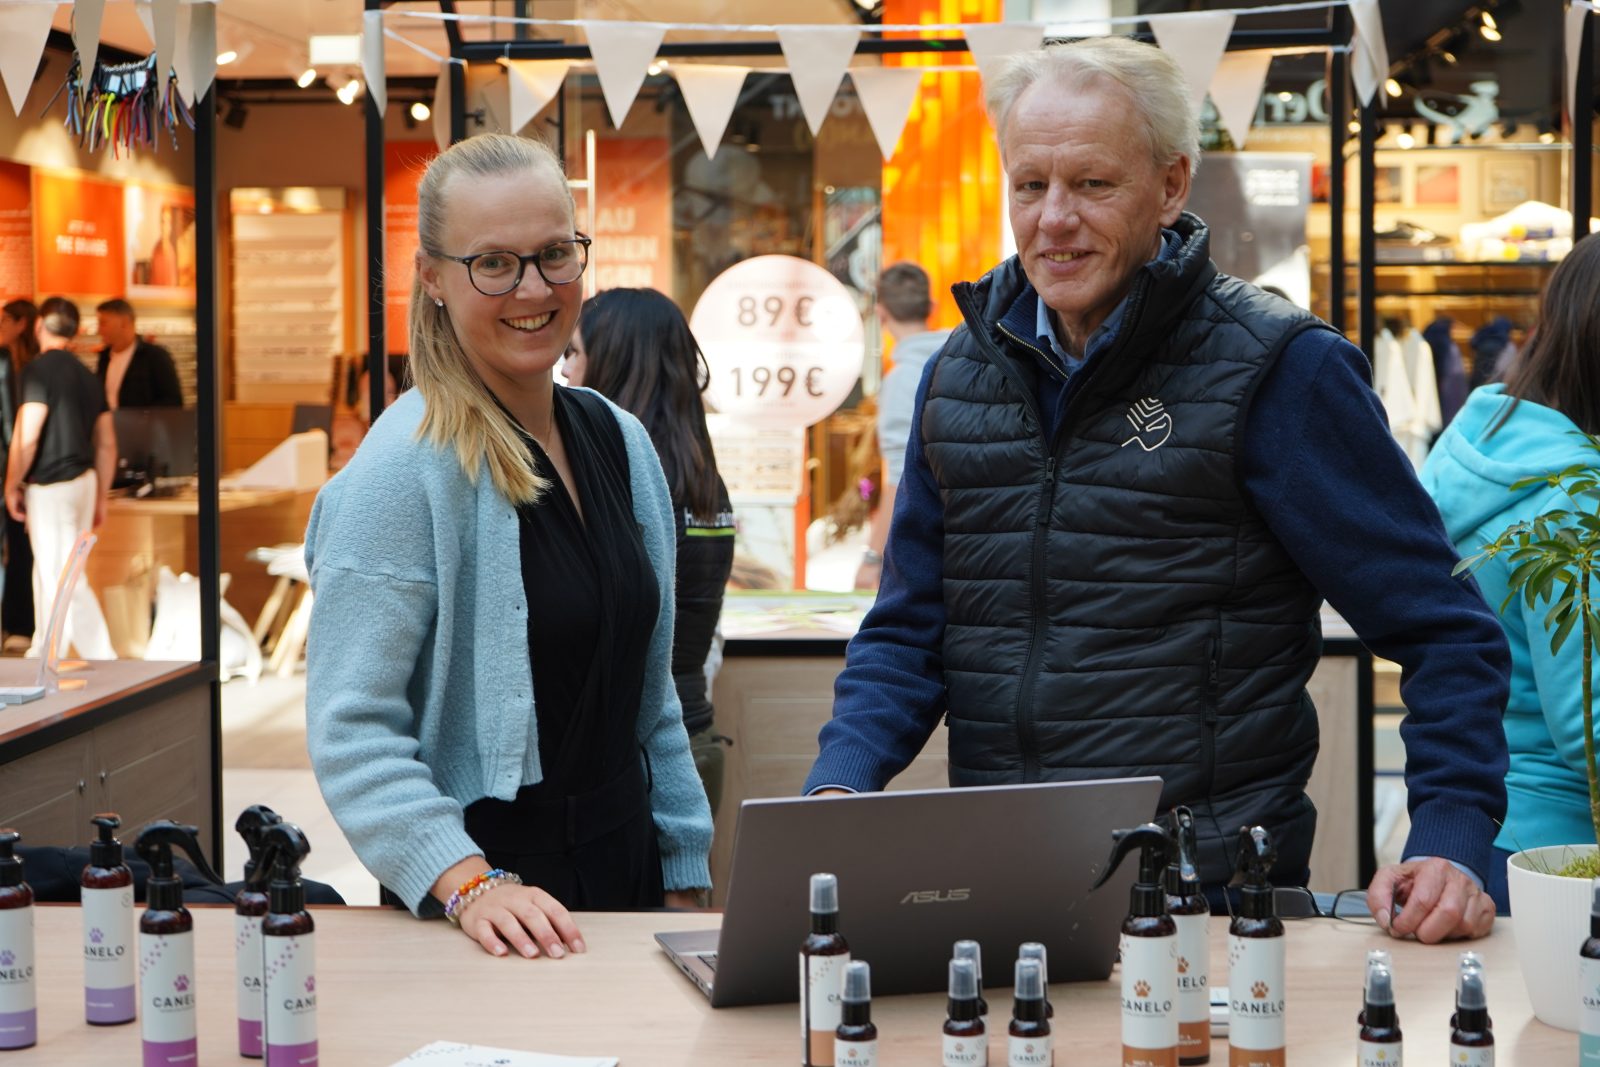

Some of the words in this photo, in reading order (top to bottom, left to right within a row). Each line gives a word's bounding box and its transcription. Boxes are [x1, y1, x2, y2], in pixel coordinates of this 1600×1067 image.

[730, 366, 825, 398] 199€
[900, 887, 971, 904] ASUS
[0, 965, 33, 980] NELO
[1232, 999, 1284, 1014] CANELO
